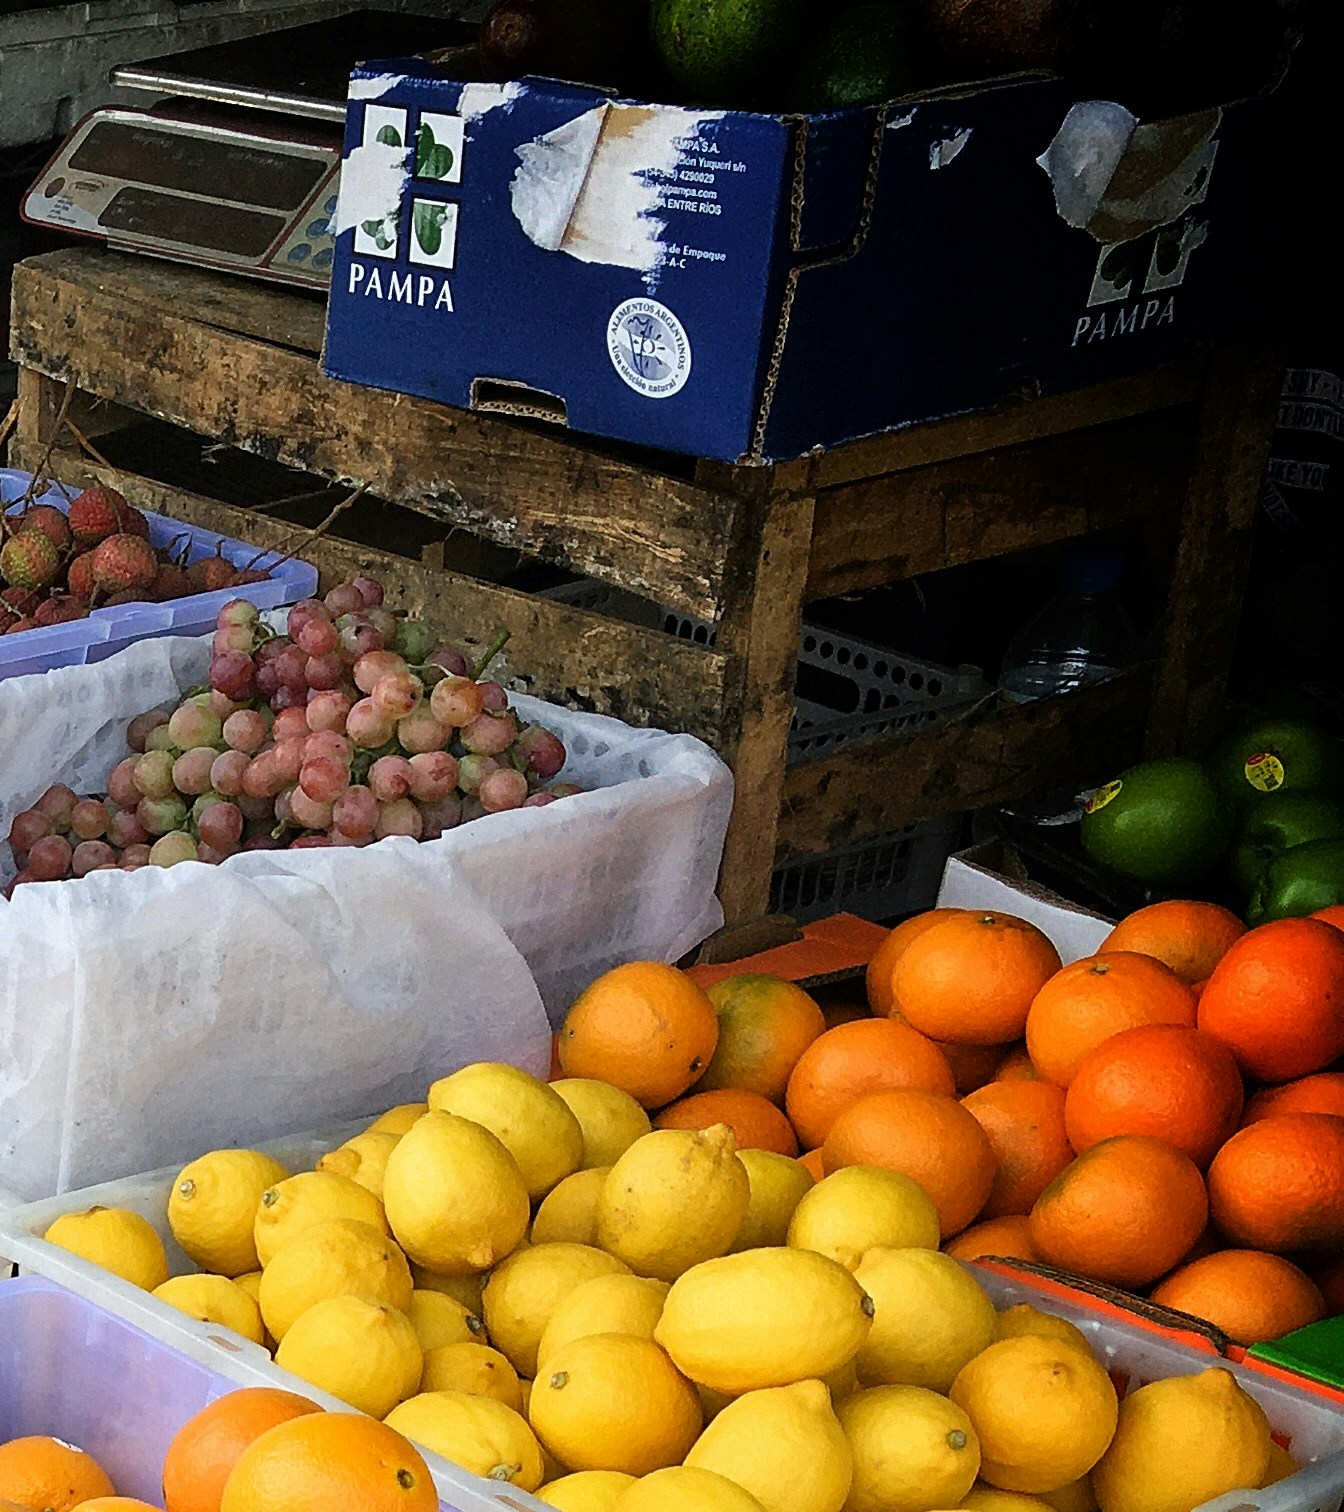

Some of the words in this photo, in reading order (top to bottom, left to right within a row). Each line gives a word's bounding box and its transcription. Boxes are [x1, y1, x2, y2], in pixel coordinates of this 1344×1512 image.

[667, 198, 698, 212] ENTRE
[348, 262, 454, 313] PAMPA
[611, 302, 655, 335] ALIMENTOS
[654, 308, 686, 371] ARGENTINOS
[1070, 295, 1175, 347] PAMPA
